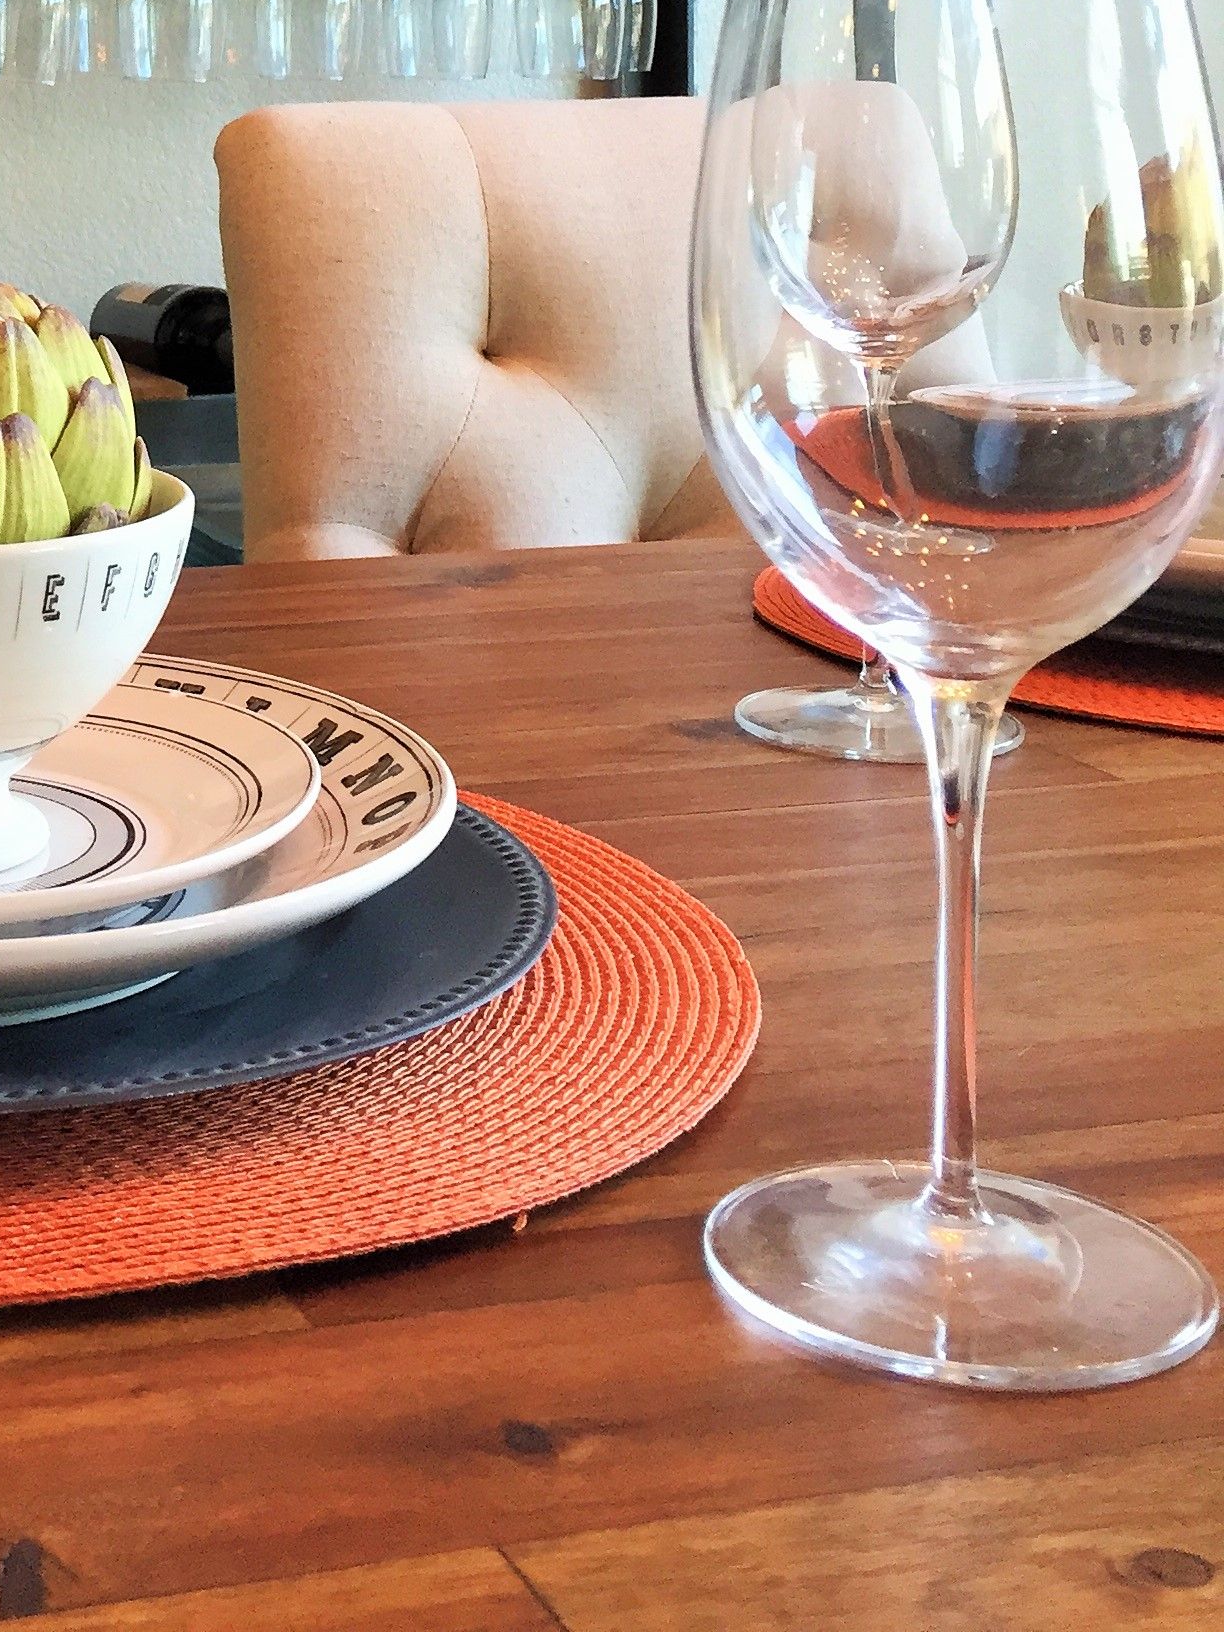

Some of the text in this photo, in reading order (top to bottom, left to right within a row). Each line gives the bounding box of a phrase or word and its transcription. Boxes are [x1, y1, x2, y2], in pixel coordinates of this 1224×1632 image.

[42, 574, 65, 622] E
[101, 564, 122, 611] F
[302, 717, 364, 767] M
[340, 752, 404, 797] N
